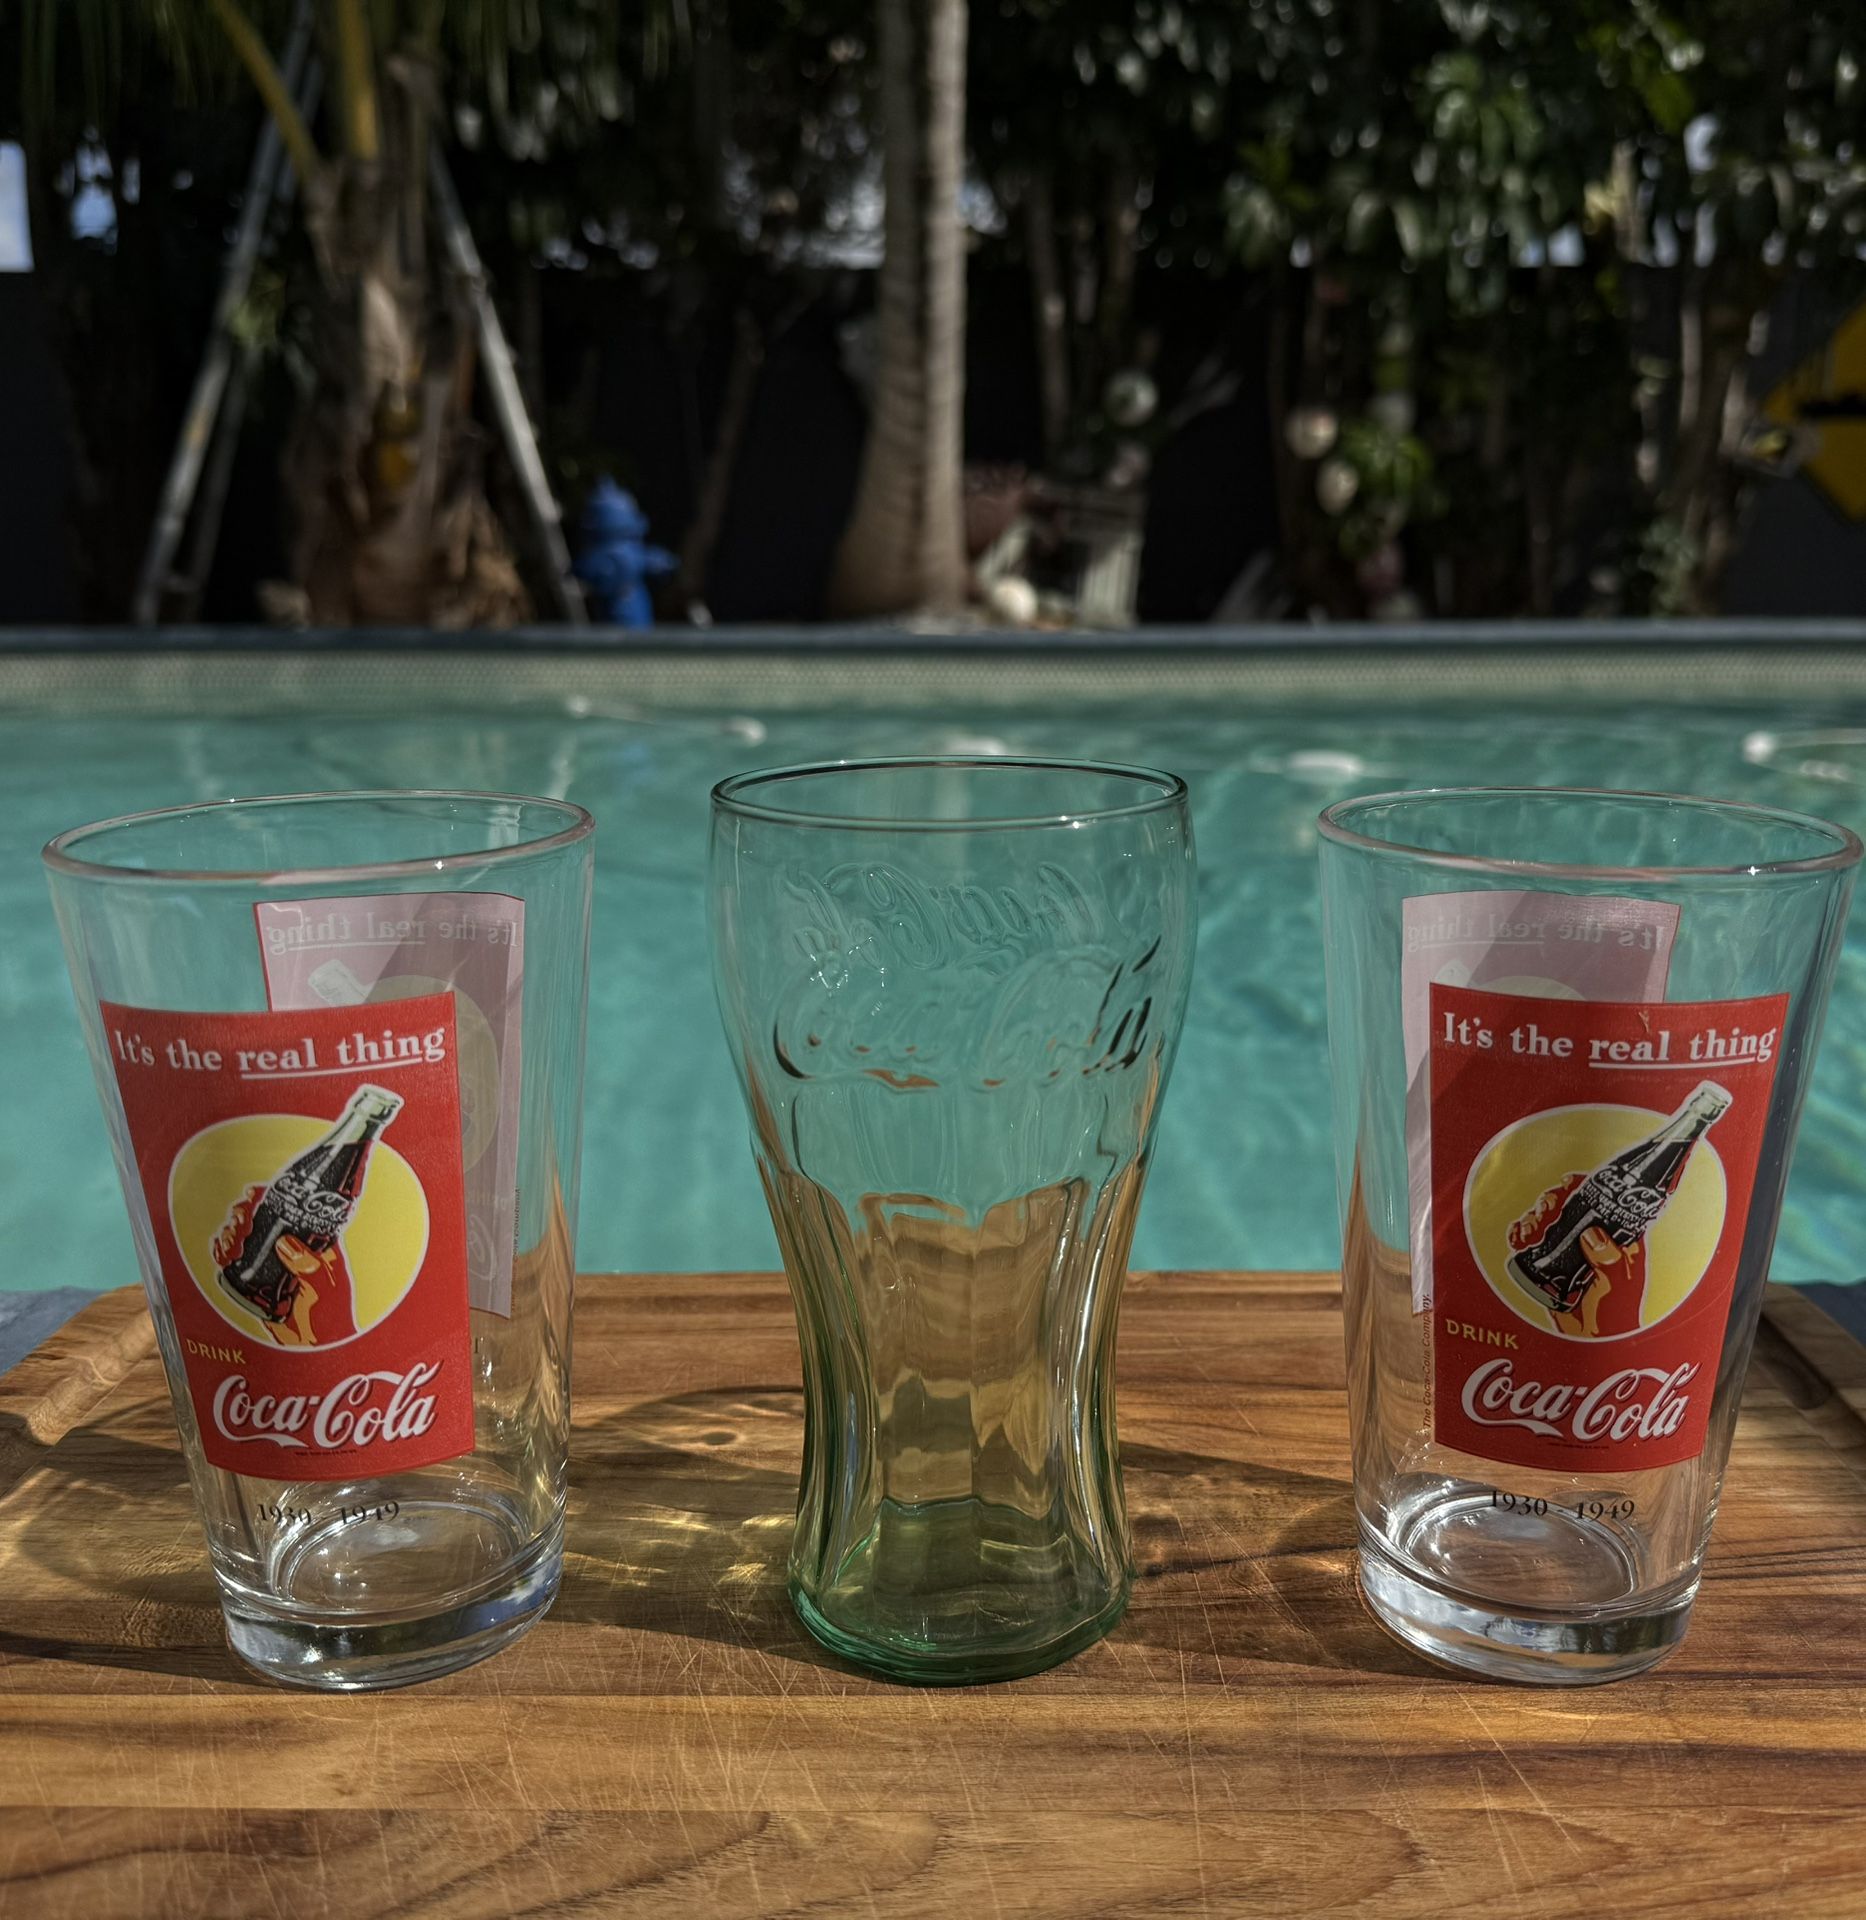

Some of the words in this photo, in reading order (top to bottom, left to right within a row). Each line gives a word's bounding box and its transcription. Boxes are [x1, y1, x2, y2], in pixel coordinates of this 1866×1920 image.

[114, 1031, 155, 1066] It's
[166, 1040, 222, 1071] the
[238, 1038, 318, 1073] real
[336, 1027, 446, 1065] thing
[1443, 1012, 1493, 1048] It's
[1511, 1024, 1574, 1057] the
[1589, 1031, 1670, 1062] real
[1689, 1027, 1777, 1063] thing
[185, 1338, 246, 1364] DRINK
[1446, 1318, 1519, 1350] DRINK
[213, 1359, 444, 1448] Coca-Cola
[1461, 1358, 1702, 1441] Coca-Cola
[257, 1503, 311, 1525] 1930
[1492, 1490, 1548, 1516] 1930
[1576, 1500, 1635, 1521] 1949
